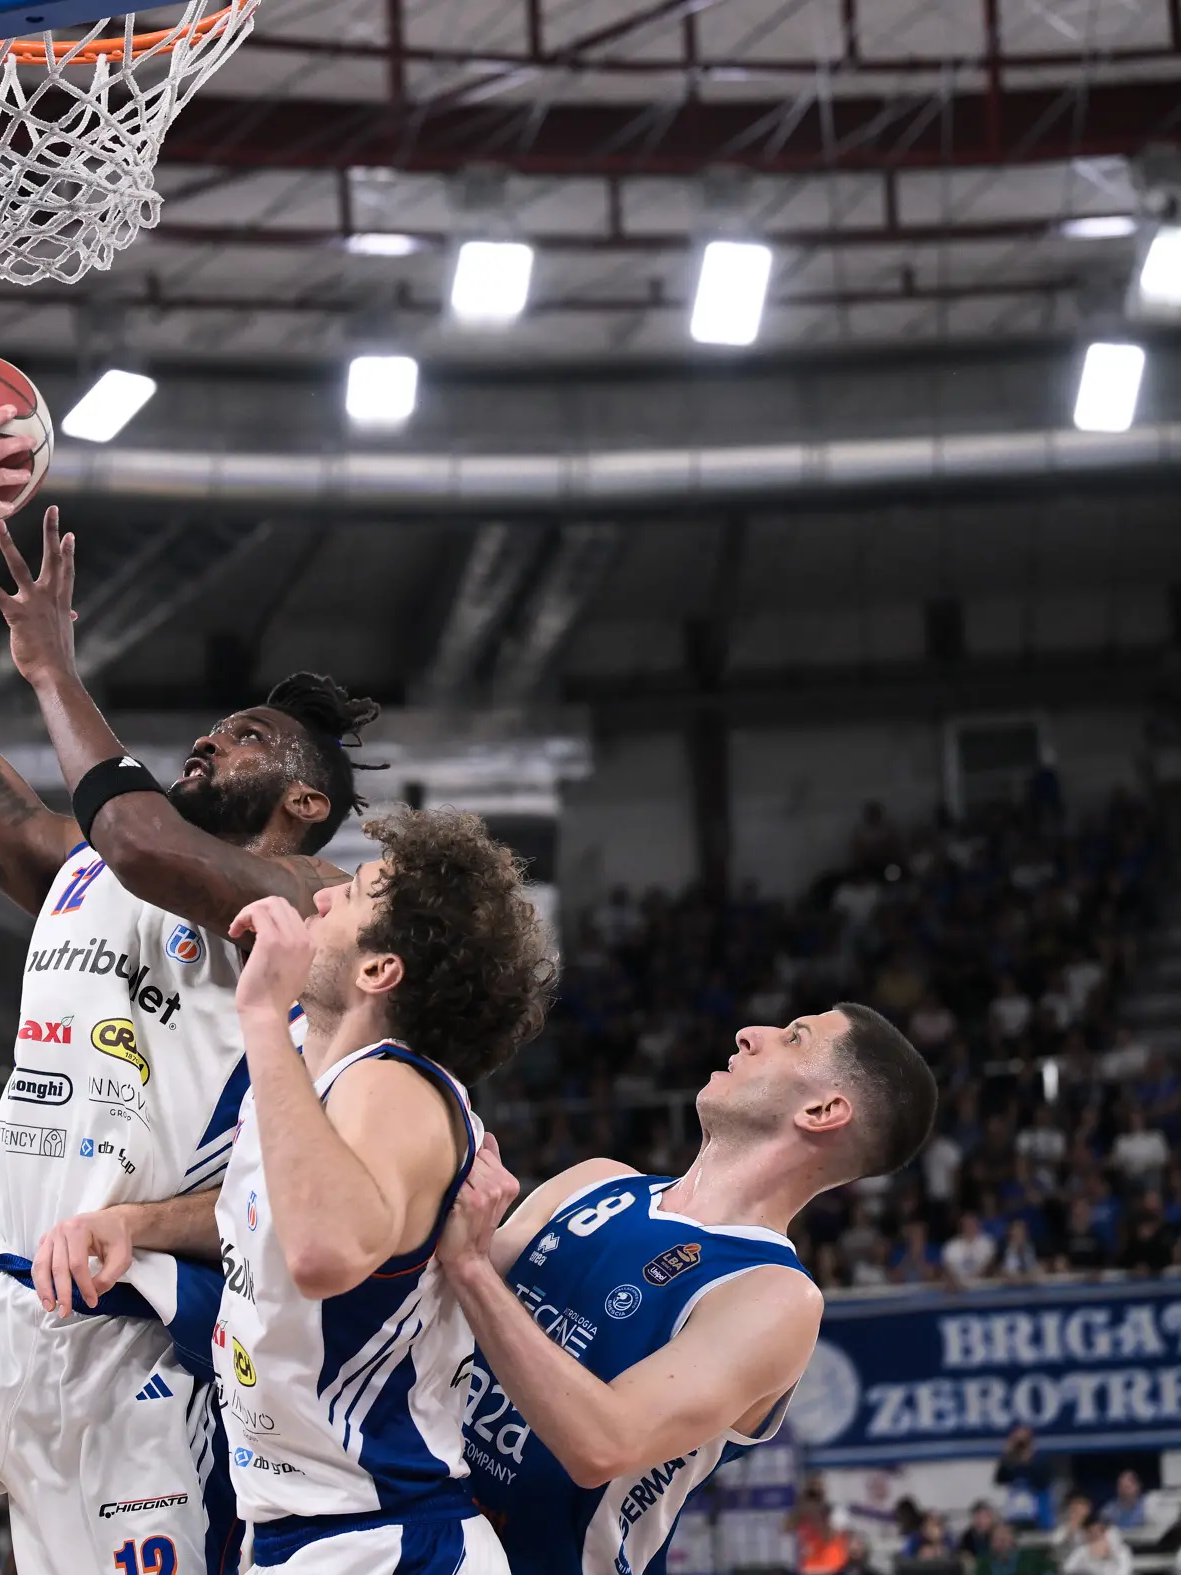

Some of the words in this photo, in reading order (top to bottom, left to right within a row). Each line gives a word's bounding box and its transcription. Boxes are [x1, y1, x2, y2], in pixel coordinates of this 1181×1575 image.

[50, 858, 106, 916] 12
[556, 1188, 636, 1237] 8
[662, 1252, 684, 1271] LBA
[99, 1495, 188, 1519] CHIGGIATO
